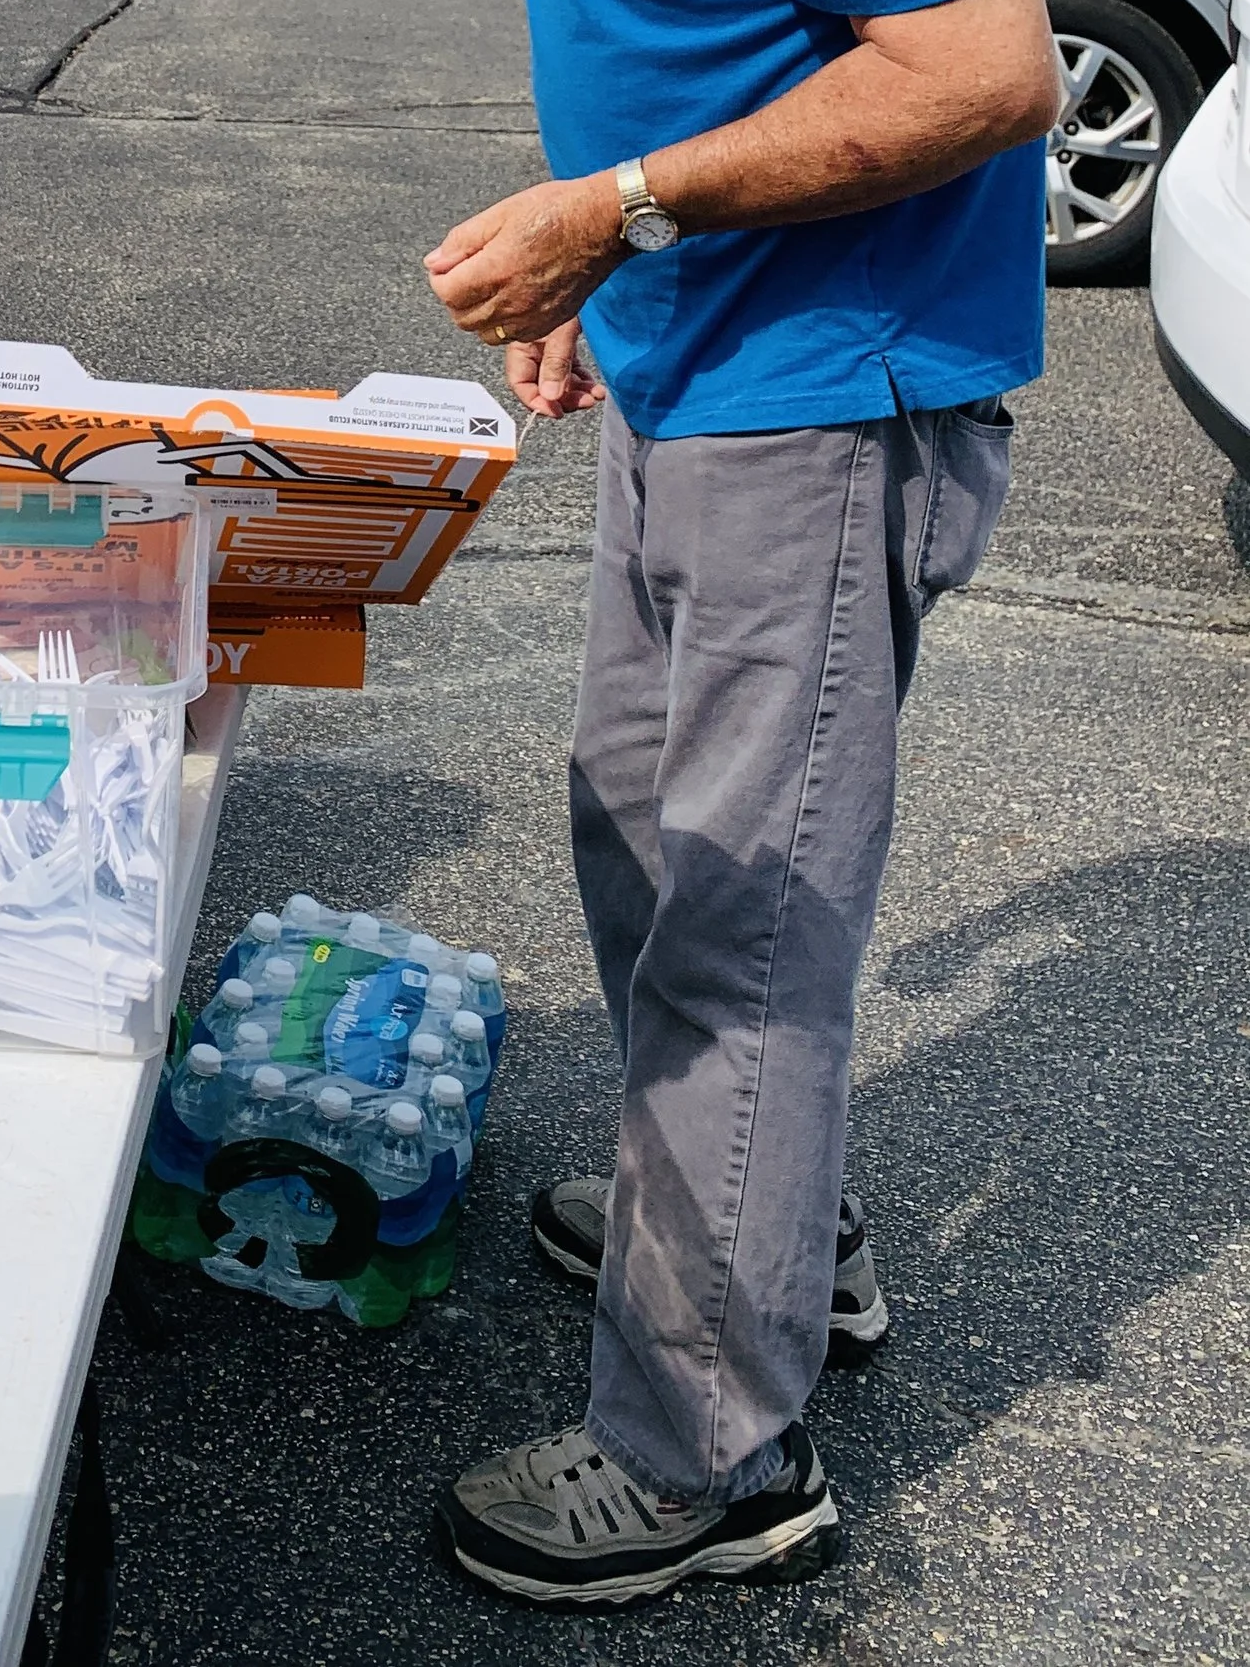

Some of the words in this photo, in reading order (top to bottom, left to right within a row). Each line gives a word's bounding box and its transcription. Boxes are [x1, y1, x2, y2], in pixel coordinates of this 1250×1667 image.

[352, 418, 378, 427] NATION
[379, 420, 410, 429] CAESARS
[410, 423, 433, 432] LITTLE
[434, 425, 448, 433] THE
[449, 426, 464, 435] JOIN
[230, 564, 370, 580] PORTAL
[246, 573, 348, 588] PIZZA
[336, 977, 370, 1012] Spring
